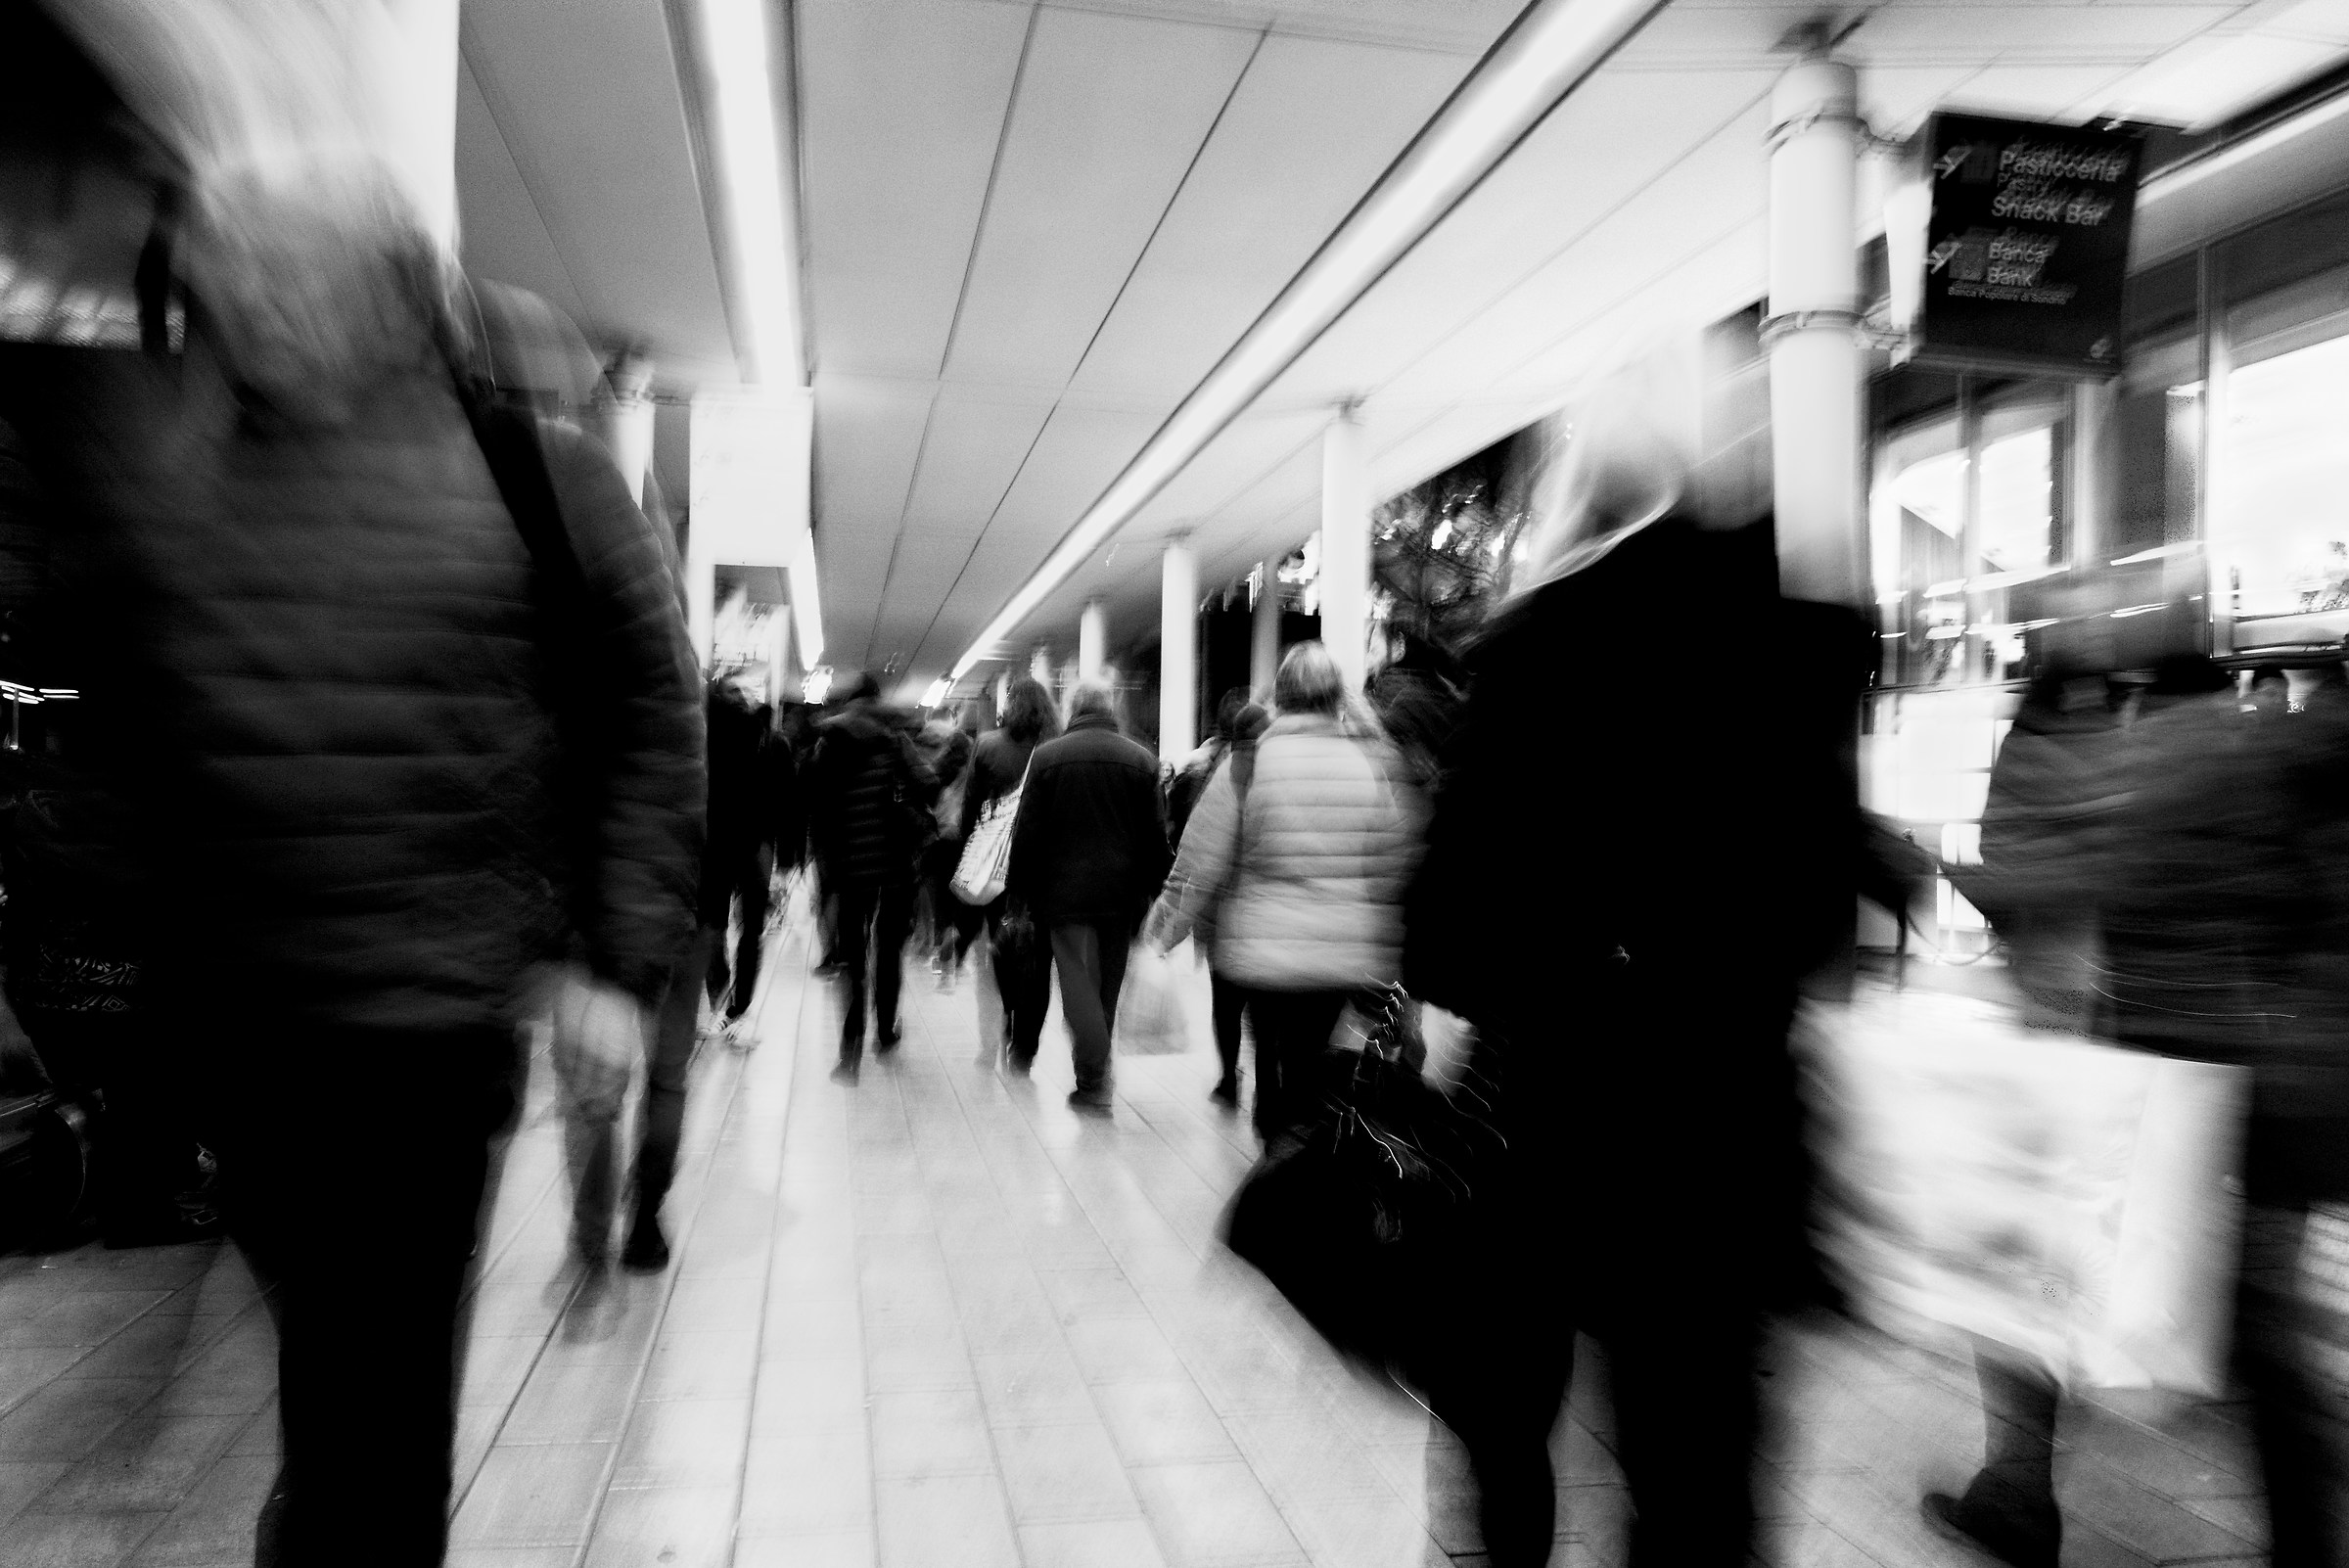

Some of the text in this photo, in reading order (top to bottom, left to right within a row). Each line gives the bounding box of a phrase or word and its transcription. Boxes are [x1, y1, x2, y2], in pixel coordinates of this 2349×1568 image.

[1991, 195, 2108, 226] Snack Bar
[1989, 242, 2050, 263] Banca
[1987, 266, 2034, 287] Bank
